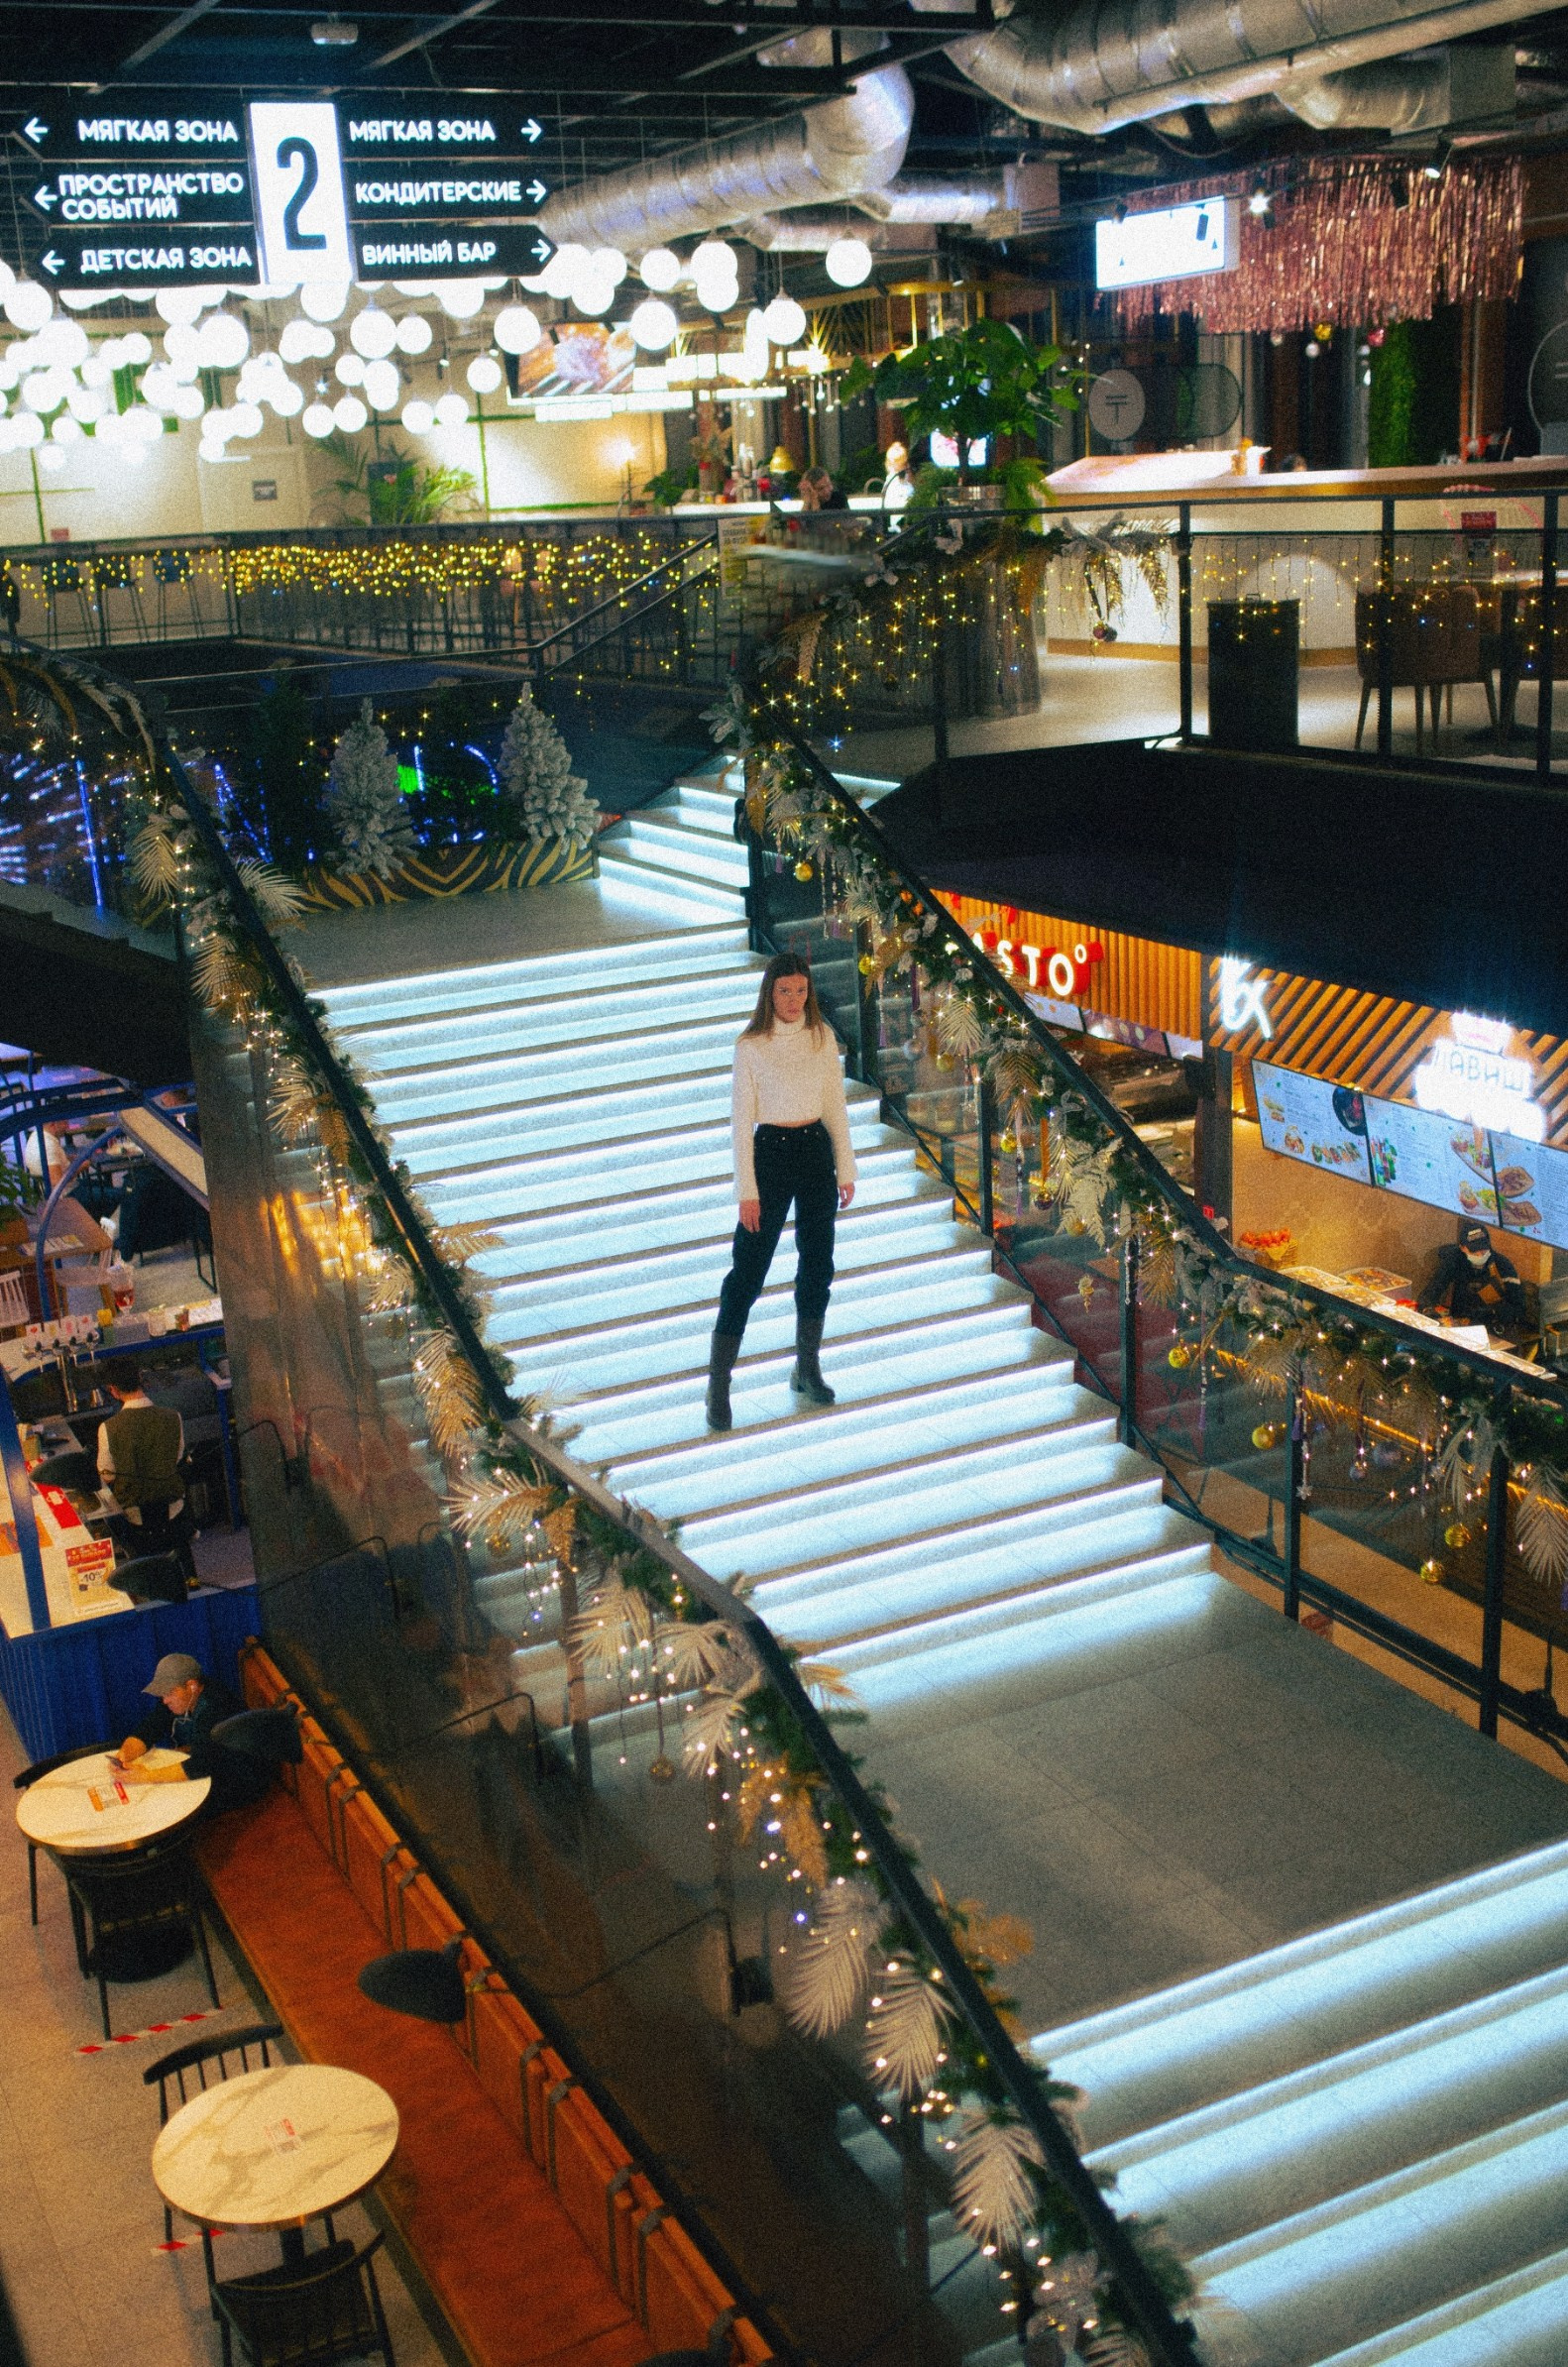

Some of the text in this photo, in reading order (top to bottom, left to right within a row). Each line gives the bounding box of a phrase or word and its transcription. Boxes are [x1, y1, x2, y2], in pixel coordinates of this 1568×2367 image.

[78, 119, 239, 143] МЯГКАЯ ЗОНА
[349, 119, 497, 142] МЯГКАЯ ЗОНА
[58, 172, 244, 196] ПРОСТРАНСТВО
[277, 137, 327, 250] 2
[355, 180, 522, 205] КОНДИТЕРСКИЕ
[61, 194, 179, 220] СОБЫТИЙ
[80, 246, 253, 274] ДЕТСКАЯ ЗОНА
[362, 239, 497, 266] ВИННЫЙ БАР
